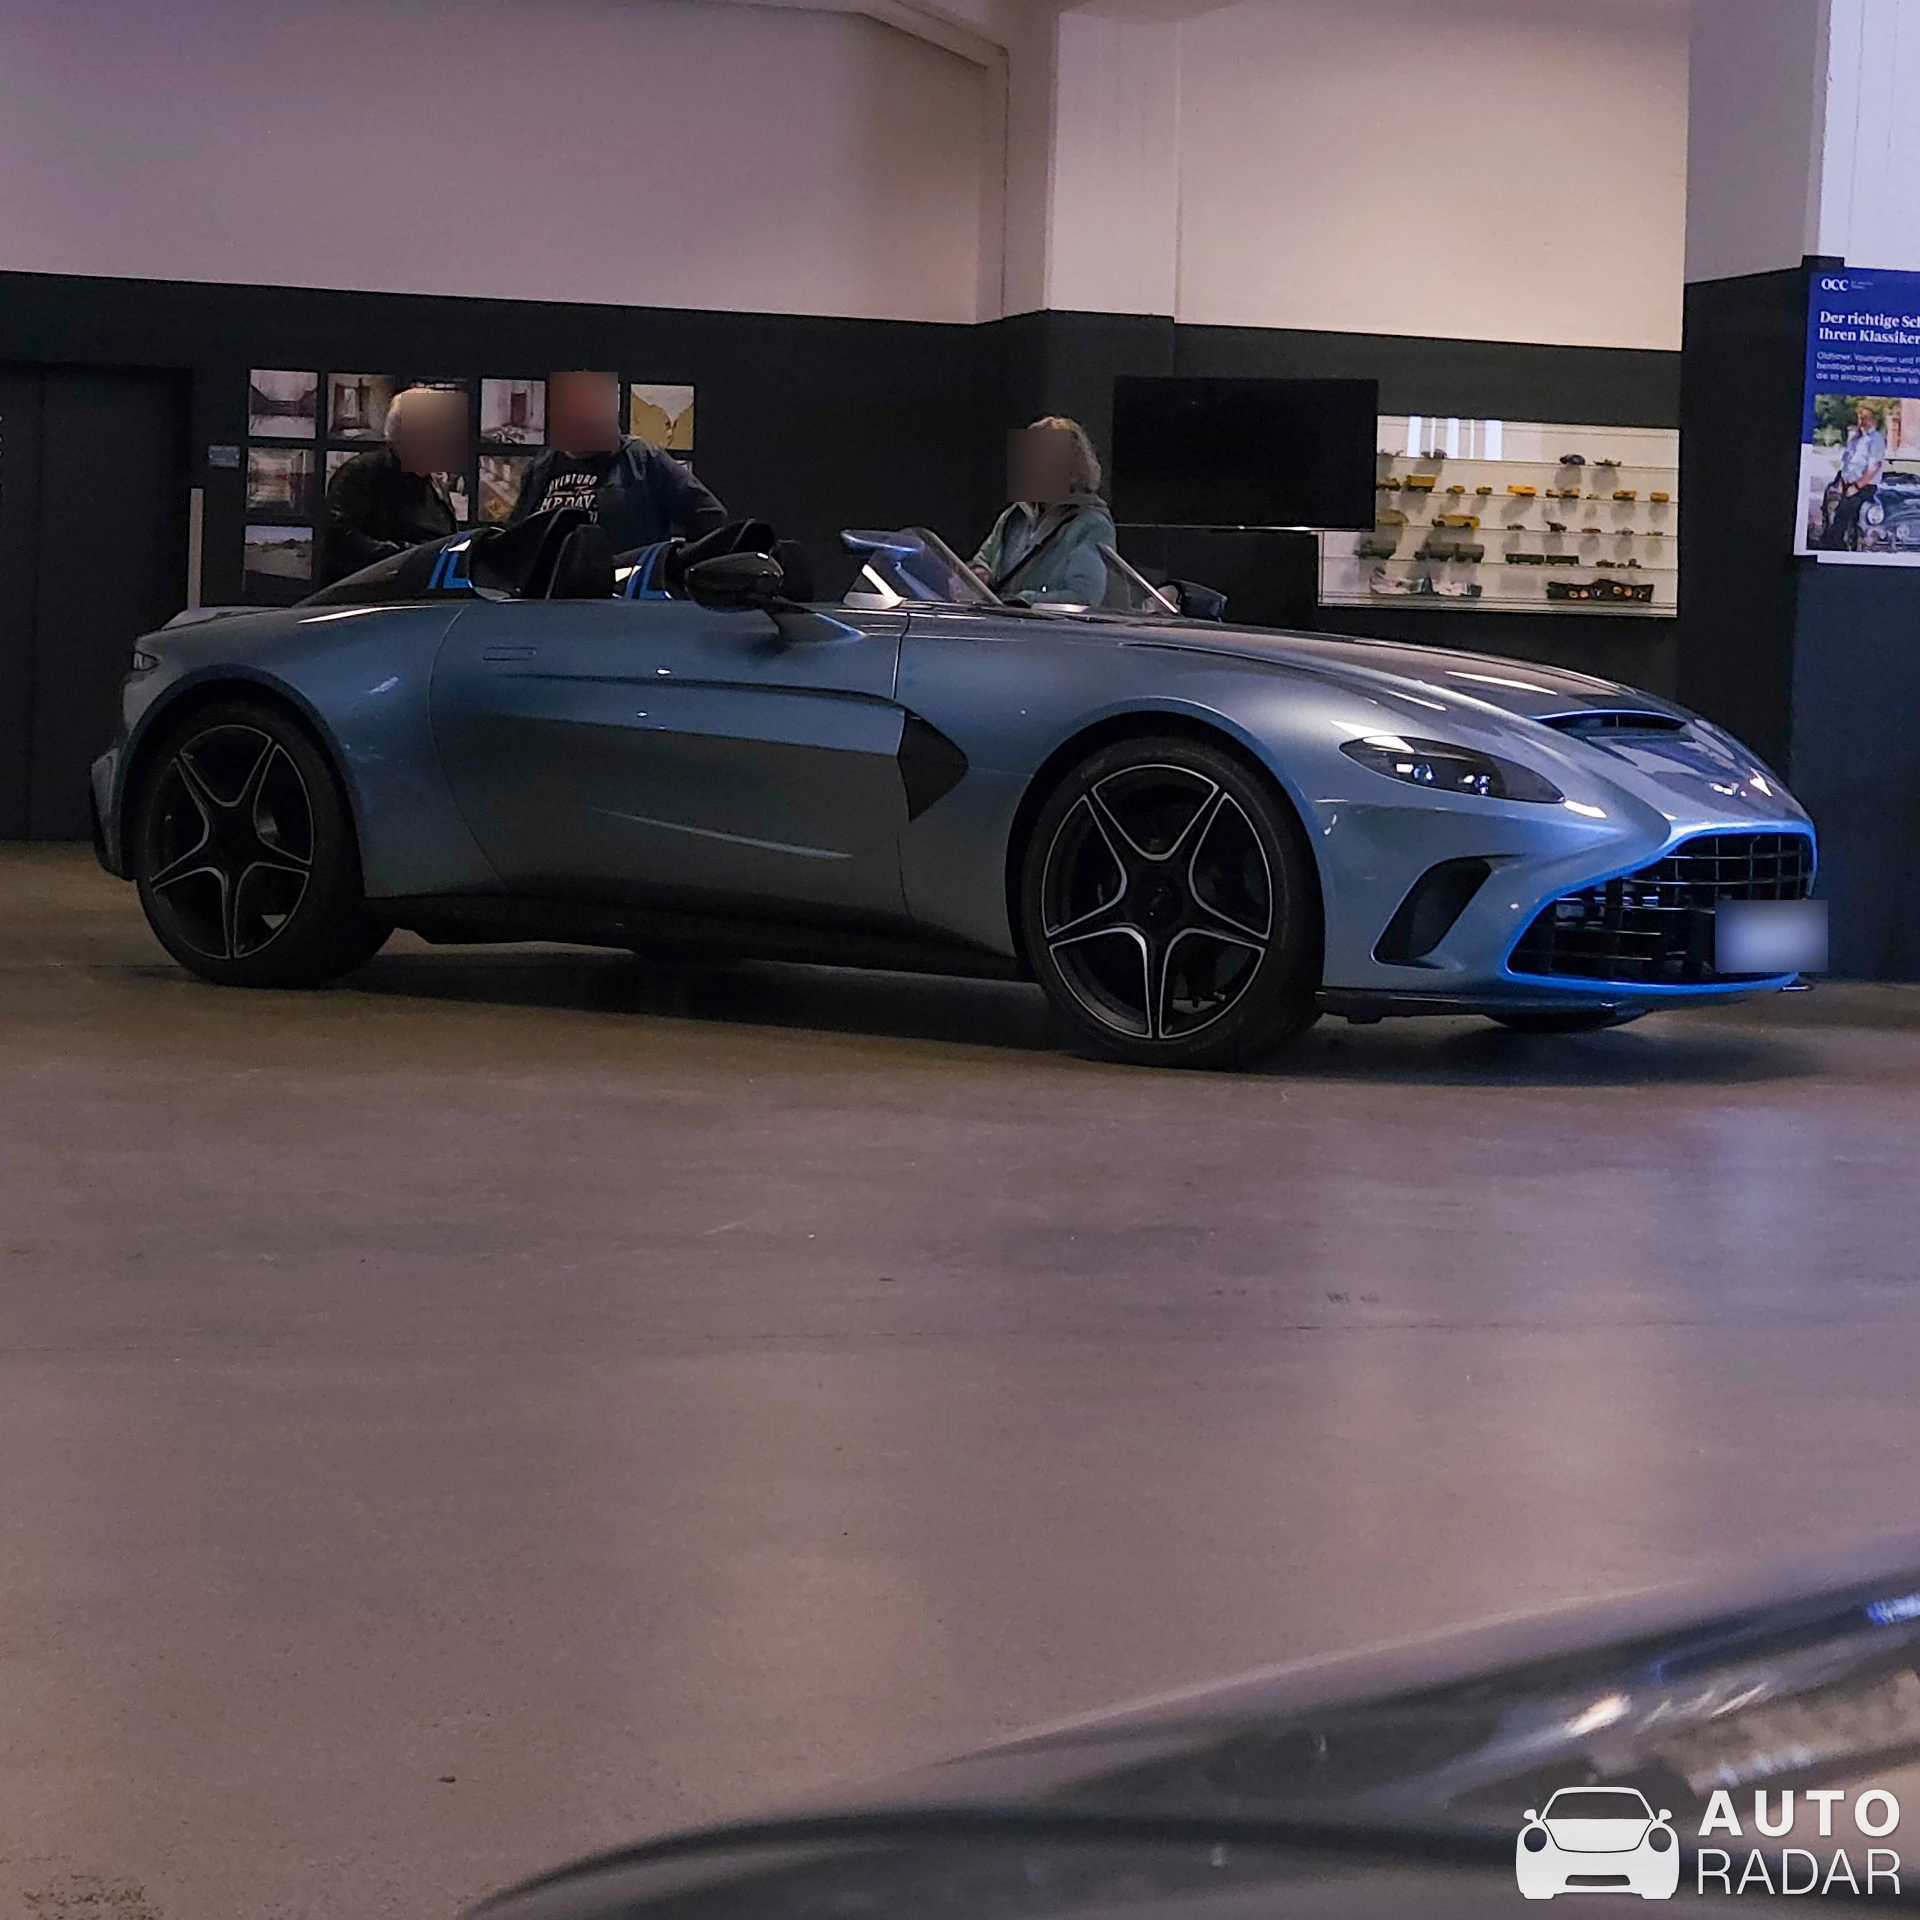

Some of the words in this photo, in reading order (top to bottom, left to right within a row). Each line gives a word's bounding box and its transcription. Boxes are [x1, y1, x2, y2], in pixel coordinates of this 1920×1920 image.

[1821, 278, 1849, 291] OCC
[1820, 311, 1845, 324] Der
[1847, 312, 1900, 330] richtige
[1819, 327, 1857, 341] Ihren
